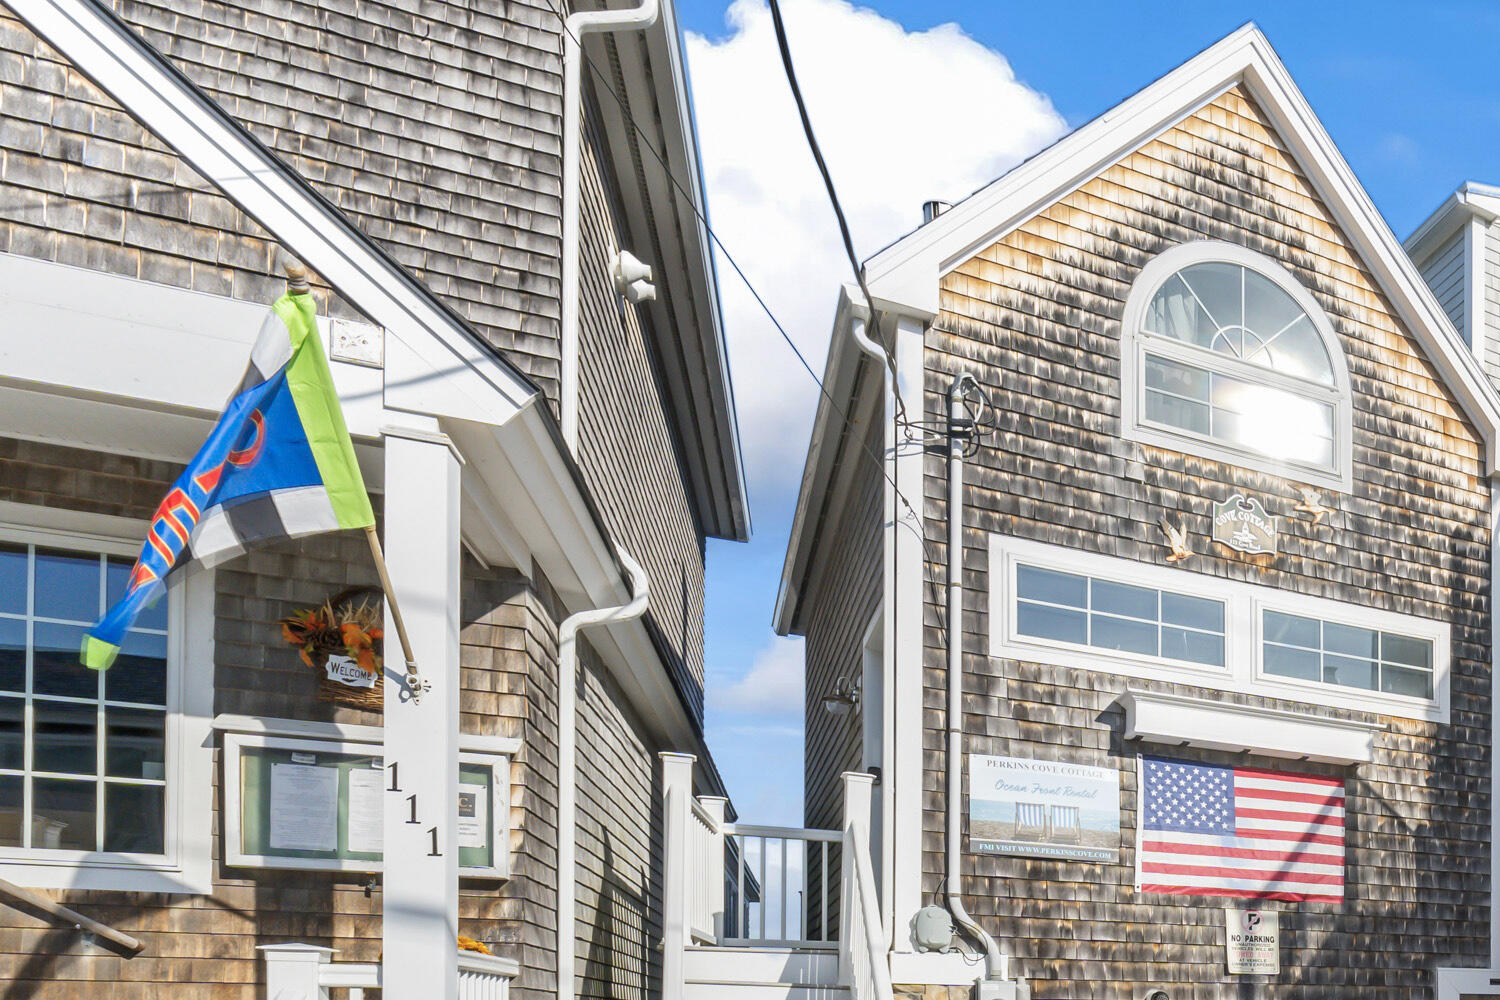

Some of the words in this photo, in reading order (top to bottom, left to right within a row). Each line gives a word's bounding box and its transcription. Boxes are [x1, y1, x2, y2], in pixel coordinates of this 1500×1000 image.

[1215, 509, 1237, 526] COVE
[1238, 511, 1275, 538] COTTAGE
[986, 759, 1029, 771] PERKINS
[1032, 763, 1056, 774] COVE
[994, 778, 1027, 793] Ocean
[1031, 782, 1060, 794] Front
[1062, 786, 1097, 800] Rental
[979, 843, 994, 851] FMI
[996, 844, 1017, 852] VISIT
[1231, 934, 1241, 942] NO
[1244, 935, 1275, 944] PARKING
